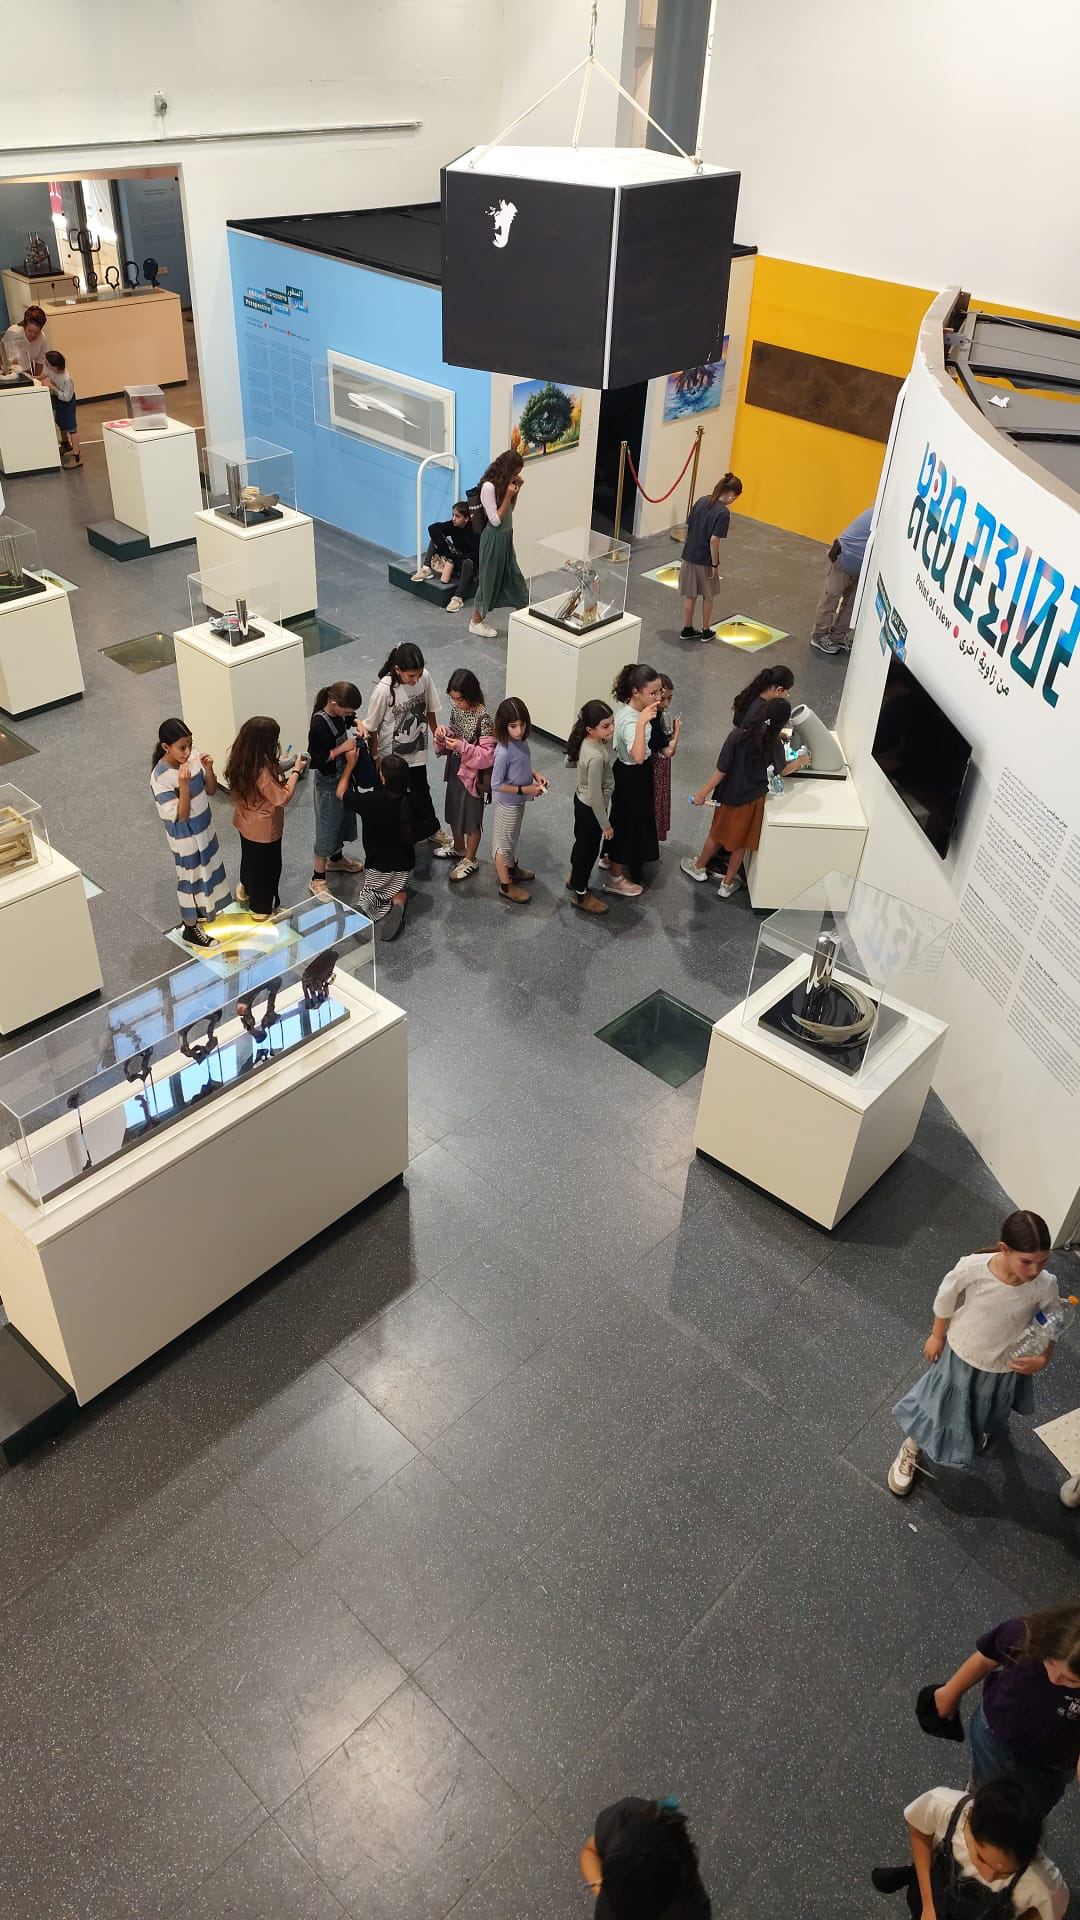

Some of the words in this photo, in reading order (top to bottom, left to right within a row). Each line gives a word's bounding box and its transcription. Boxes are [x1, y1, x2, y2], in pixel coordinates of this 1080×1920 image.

[915, 573, 930, 602] Point
[928, 598, 937, 611] of
[935, 605, 952, 630] view
[996, 679, 1010, 697] من
